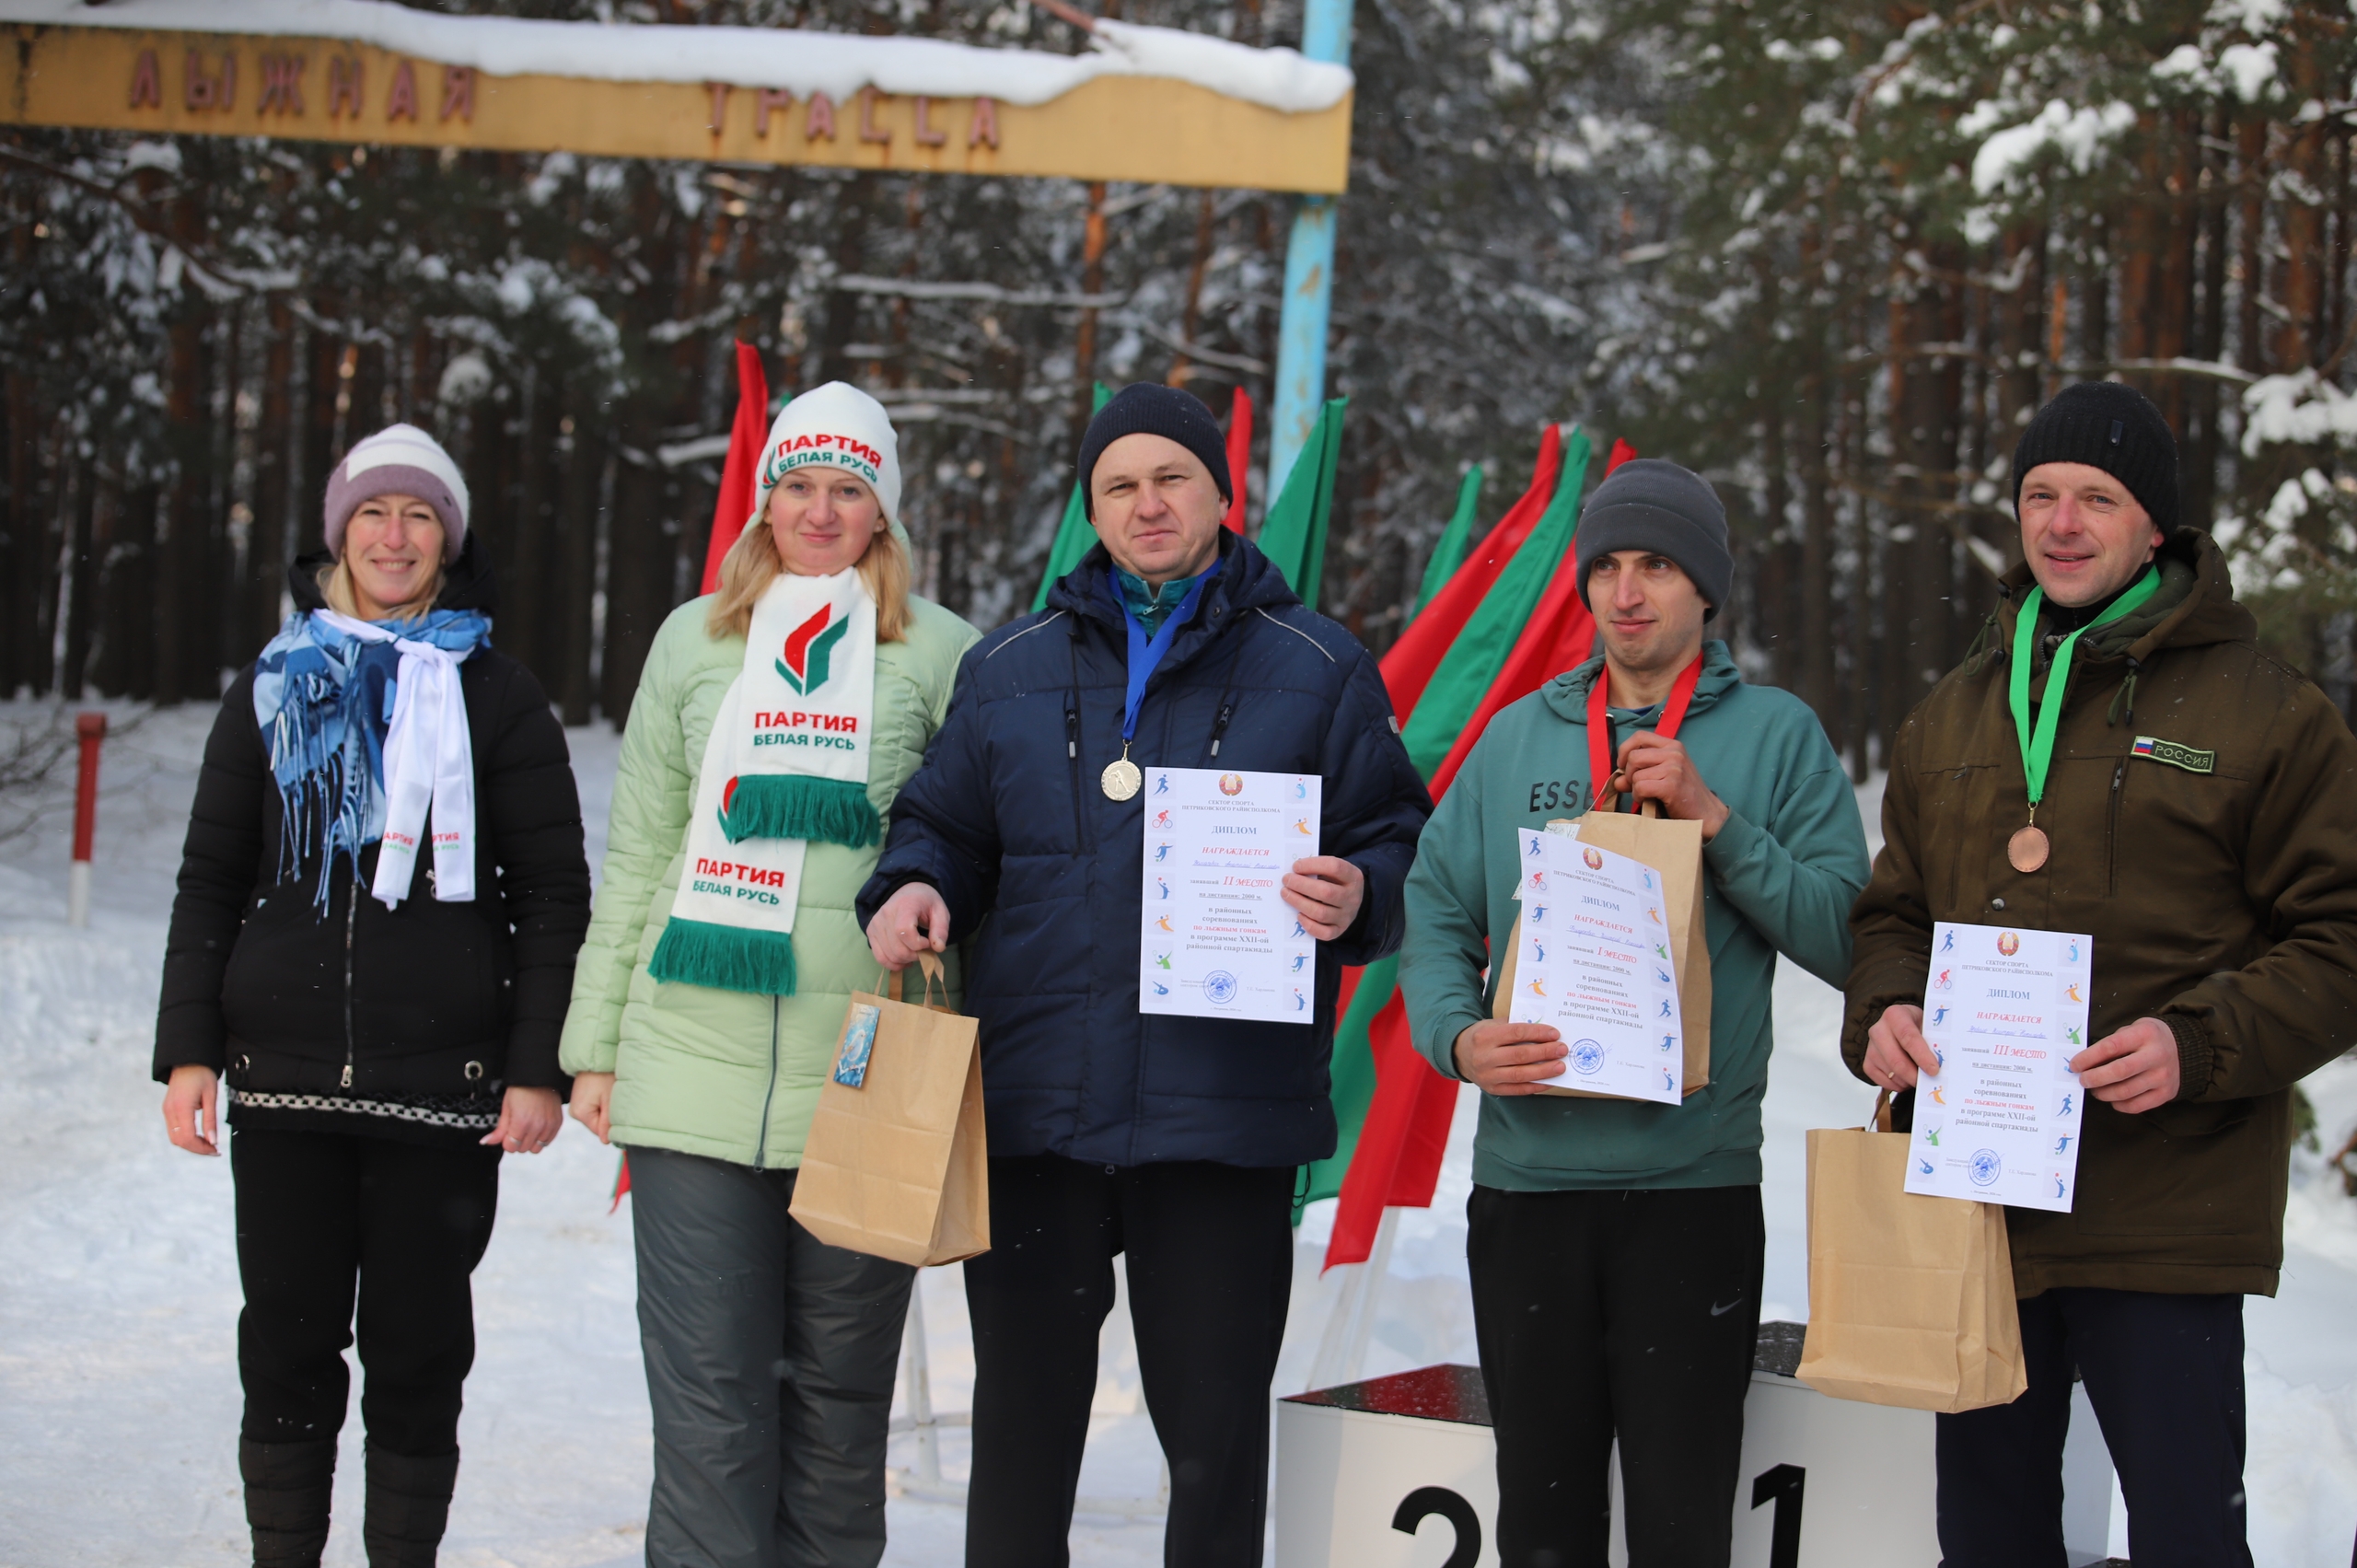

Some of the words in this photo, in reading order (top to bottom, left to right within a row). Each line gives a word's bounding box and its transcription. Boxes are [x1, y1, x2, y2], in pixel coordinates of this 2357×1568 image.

[129, 48, 476, 124] ЛЫЖНАЯ
[778, 434, 882, 470] ПАРТИЯ
[778, 452, 833, 473] БЕЛАЯ
[840, 454, 878, 483] РУСЬ
[754, 711, 858, 734] ПАРТИЯ
[753, 733, 809, 747] БЕЛАЯ
[814, 735, 855, 751] РУСЬ
[2154, 745, 2209, 769] РОССИЯ
[1211, 825, 1257, 835] ДИПЛОМ
[383, 831, 413, 846] АРТИЯ
[1202, 846, 1270, 856] НАГРАЖДАЕТСЯ
[696, 857, 785, 889] ПАРТИЯ
[1575, 869, 1594, 879] СЕКТОР
[1595, 873, 1615, 884] СПОРТА
[1223, 876, 1235, 886] II
[1235, 878, 1273, 888] МЕСТО
[692, 878, 732, 898] БЕЛАЯ
[736, 887, 780, 906] РУСЬ
[1214, 906, 1252, 915] районных
[1580, 895, 1620, 912] ДИПЛОМ
[1202, 916, 1258, 924] соревнованиях
[1573, 913, 1633, 935] НАГРАЖДАЕТСЯ
[1196, 935, 1237, 943] программе
[1239, 935, 1270, 944] XXII-ой
[1186, 942, 1223, 951] районной
[1223, 946, 1273, 954] спартакиады
[1596, 947, 1603, 956] I
[1603, 949, 1638, 964] МЕСТО
[1587, 976, 1623, 988] районных
[1575, 983, 1629, 999] соревнованиях
[1986, 988, 2030, 1000] ДИПЛОМ
[1576, 993, 1610, 1004] лыжным
[1610, 999, 1637, 1009] гонкам
[1569, 1002, 1610, 1014] программе
[1610, 1006, 1640, 1019] XXII-ой
[1976, 1011, 2042, 1025] НАГРАЖДАЕТСЯ
[1557, 1009, 1595, 1020] районной
[1596, 1016, 1643, 1029] спартакиады
[1992, 1044, 2010, 1056] III
[2009, 1048, 2047, 1060] МЕСТО
[1986, 1078, 2023, 1089] районных
[1973, 1088, 2027, 1100] соревнованиях
[1974, 1099, 2007, 1109] лыжным
[2008, 1102, 2035, 1111] гонкам
[1967, 1109, 2006, 1119] программе
[2006, 1111, 2036, 1122] XXII-ой
[1955, 1118, 1991, 1128] районной
[1991, 1121, 2038, 1133] спартакиады
[1751, 1463, 1806, 1568] 1
